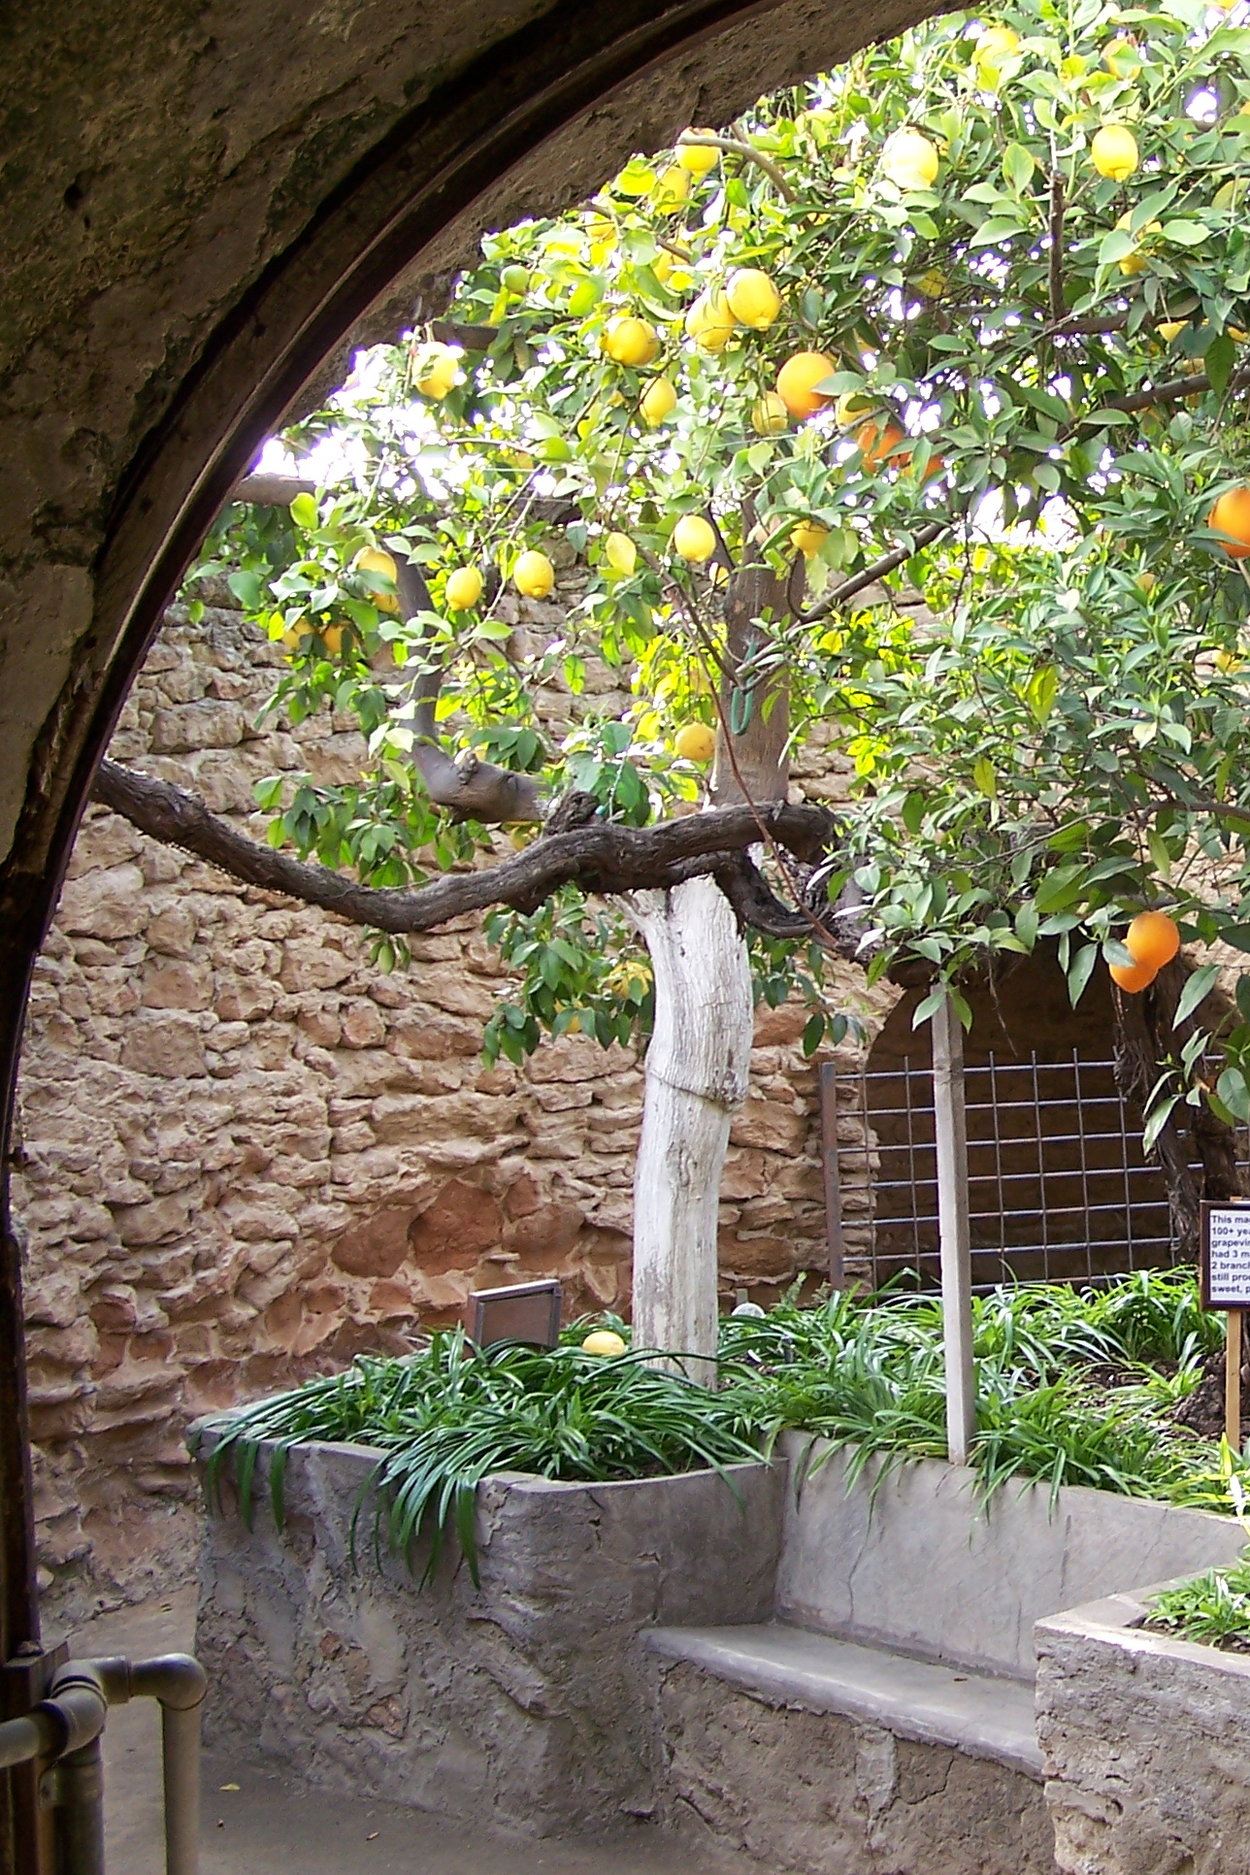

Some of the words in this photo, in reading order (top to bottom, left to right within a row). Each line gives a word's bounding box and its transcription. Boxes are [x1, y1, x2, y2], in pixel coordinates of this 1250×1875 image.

[1211, 1215, 1232, 1224] This
[1212, 1227, 1234, 1235] 100+
[1211, 1250, 1229, 1258] had
[1232, 1250, 1238, 1258] 3
[1211, 1273, 1229, 1281] still
[1211, 1285, 1243, 1293] sweet,
